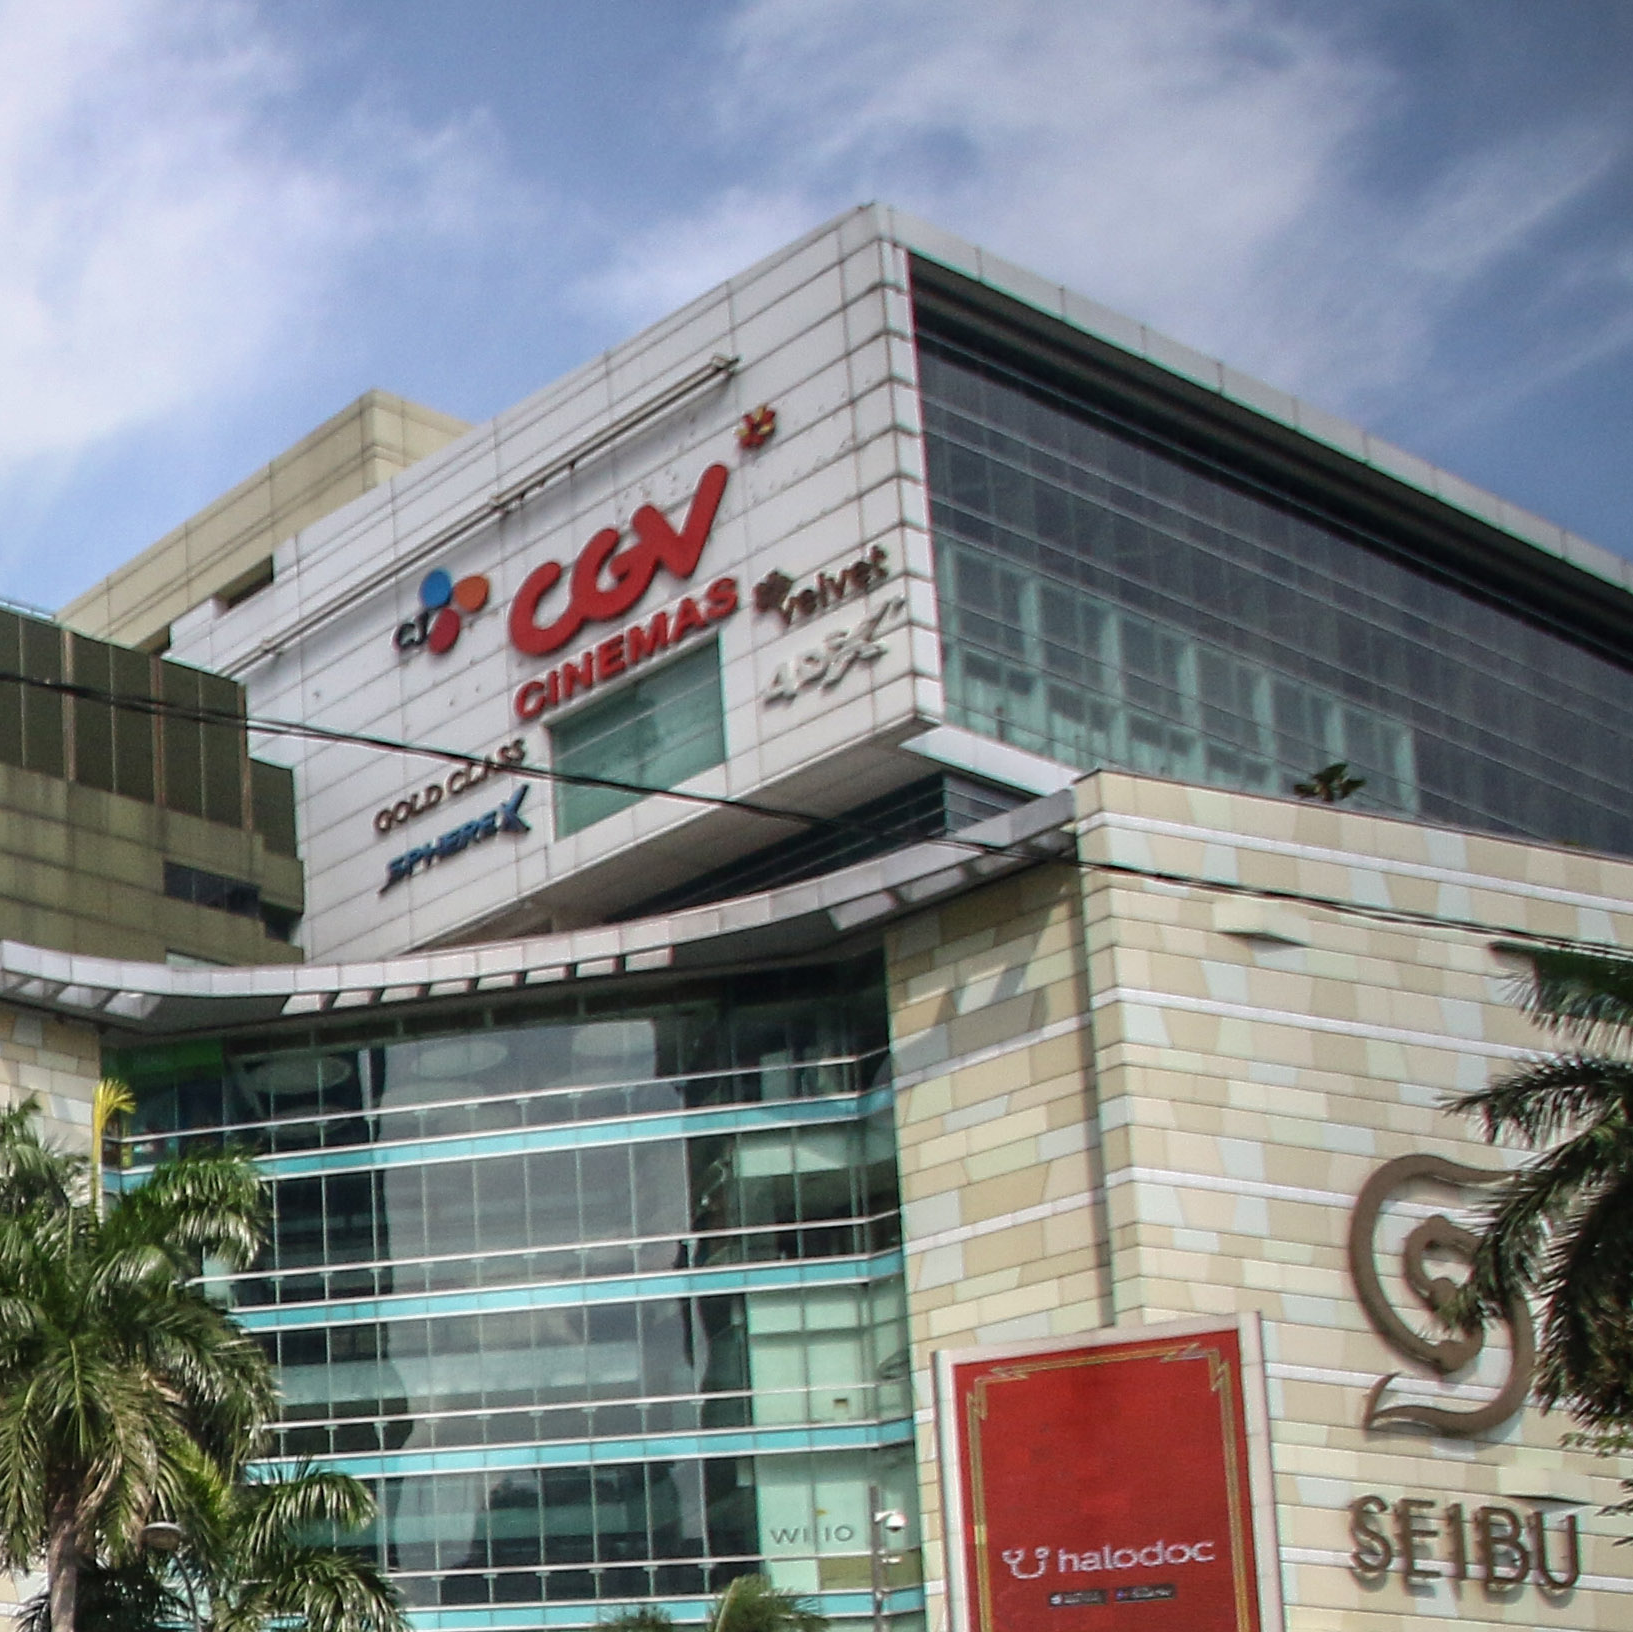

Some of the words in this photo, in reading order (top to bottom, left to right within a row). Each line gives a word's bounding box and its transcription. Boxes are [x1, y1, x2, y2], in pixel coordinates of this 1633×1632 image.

[508, 463, 729, 657] CGV
[513, 578, 739, 720] CINEMAS
[373, 782, 444, 833] GOLD
[445, 737, 525, 796] CLASS
[1057, 1539, 1216, 1574] halodoc
[1347, 1494, 1581, 1590] SEIBU
